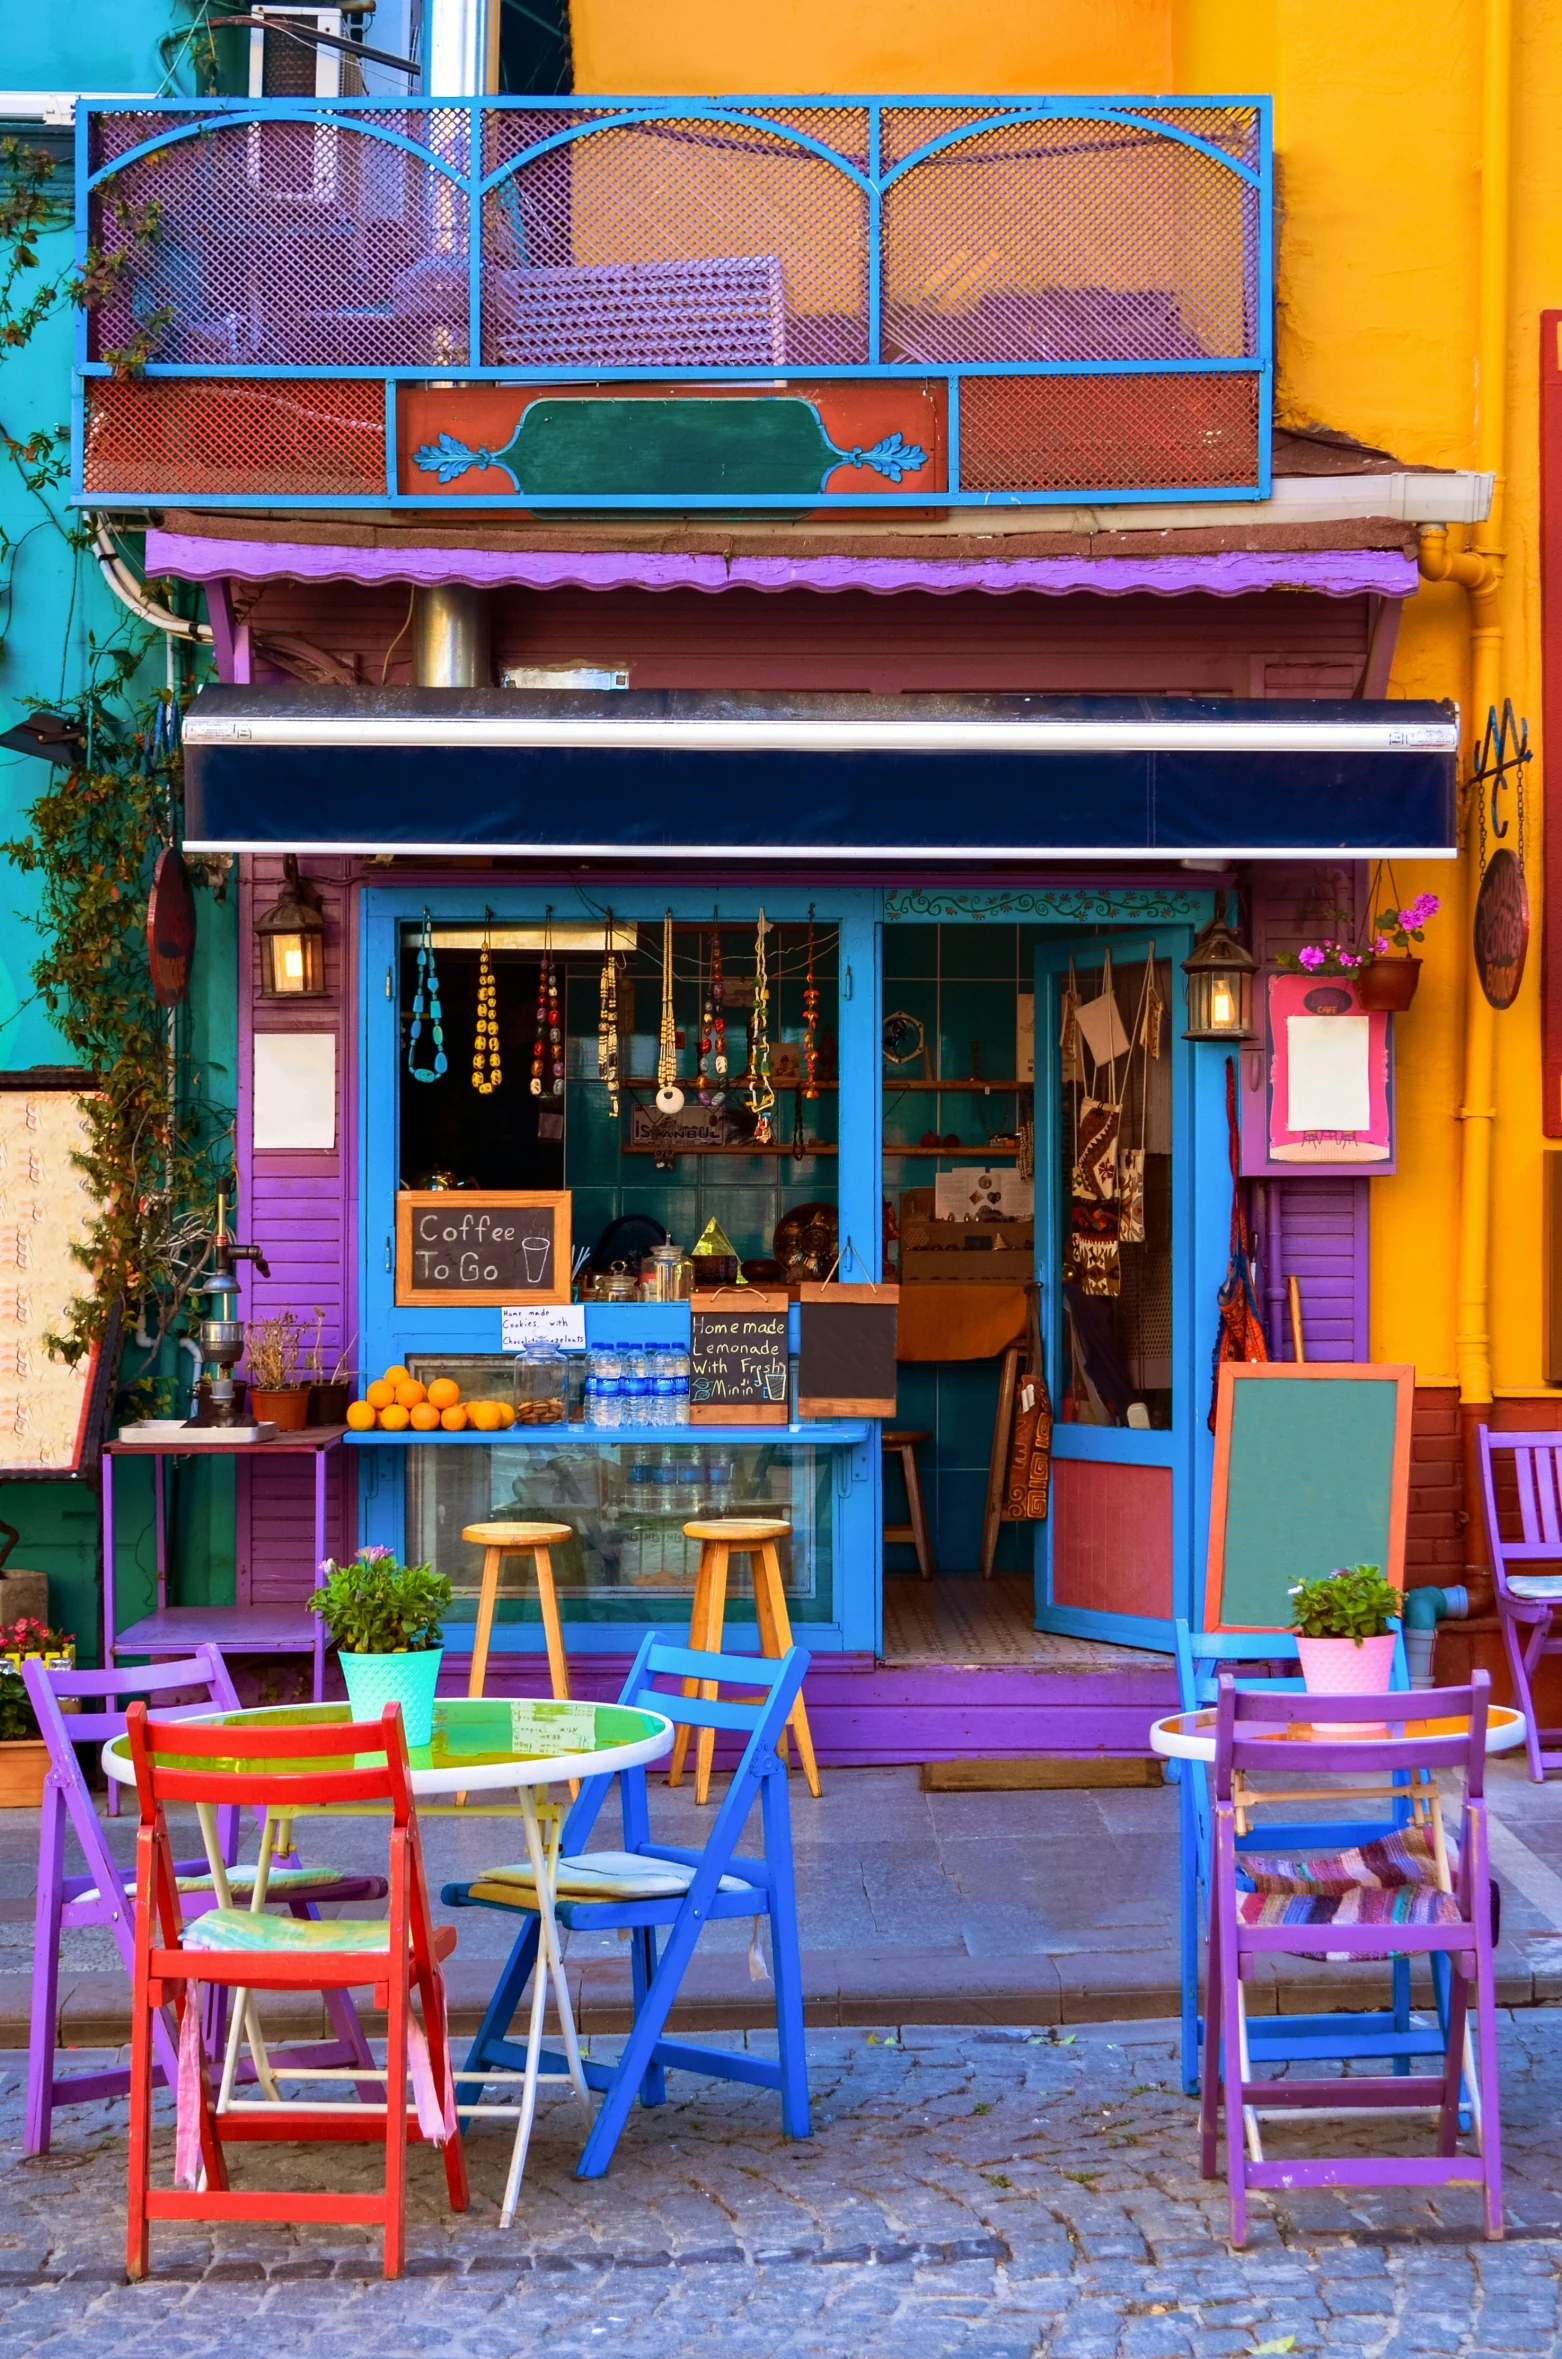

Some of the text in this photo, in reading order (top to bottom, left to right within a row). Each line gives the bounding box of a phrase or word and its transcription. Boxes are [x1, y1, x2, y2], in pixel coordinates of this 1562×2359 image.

[635, 1120, 720, 1139] İSANBUL
[419, 1214, 515, 1243] Coffee
[415, 1250, 499, 1282] To Go
[503, 1308, 550, 1317] Home made
[502, 1316, 569, 1329] Cookies with
[692, 1336, 780, 1357] Lemonade
[692, 1356, 780, 1375] With Fresh
